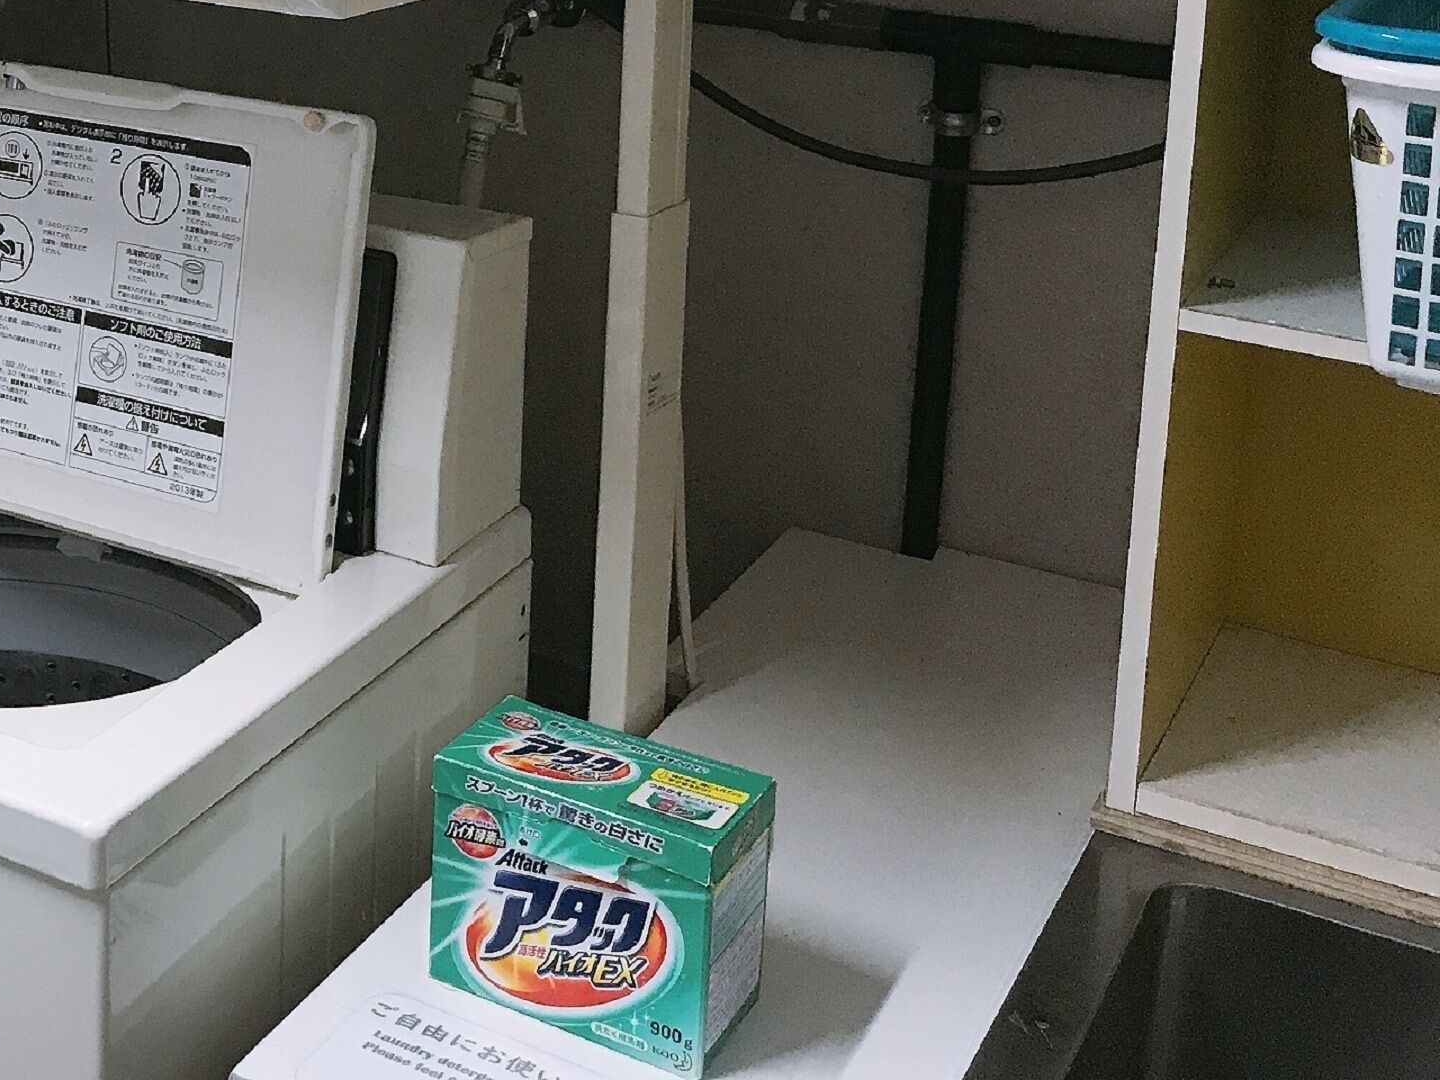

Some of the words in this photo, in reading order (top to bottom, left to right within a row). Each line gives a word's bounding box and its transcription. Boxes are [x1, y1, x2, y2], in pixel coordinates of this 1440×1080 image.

[109, 148, 123, 166] 2
[109, 319, 202, 350] ソフト剤のご使用方法
[96, 393, 208, 430] 洗濯機の据え付けについて
[140, 420, 160, 435] 警告
[504, 735, 631, 772] アタック
[466, 776, 556, 816] スプーン1杯で
[558, 804, 665, 854] 驚きの白さに
[495, 848, 549, 875] Attack
[482, 870, 650, 955] アタック
[517, 943, 547, 960] 高活性
[538, 948, 647, 989] バイオEX
[362, 1041, 402, 1067] Please
[374, 1029, 434, 1060] Laundry
